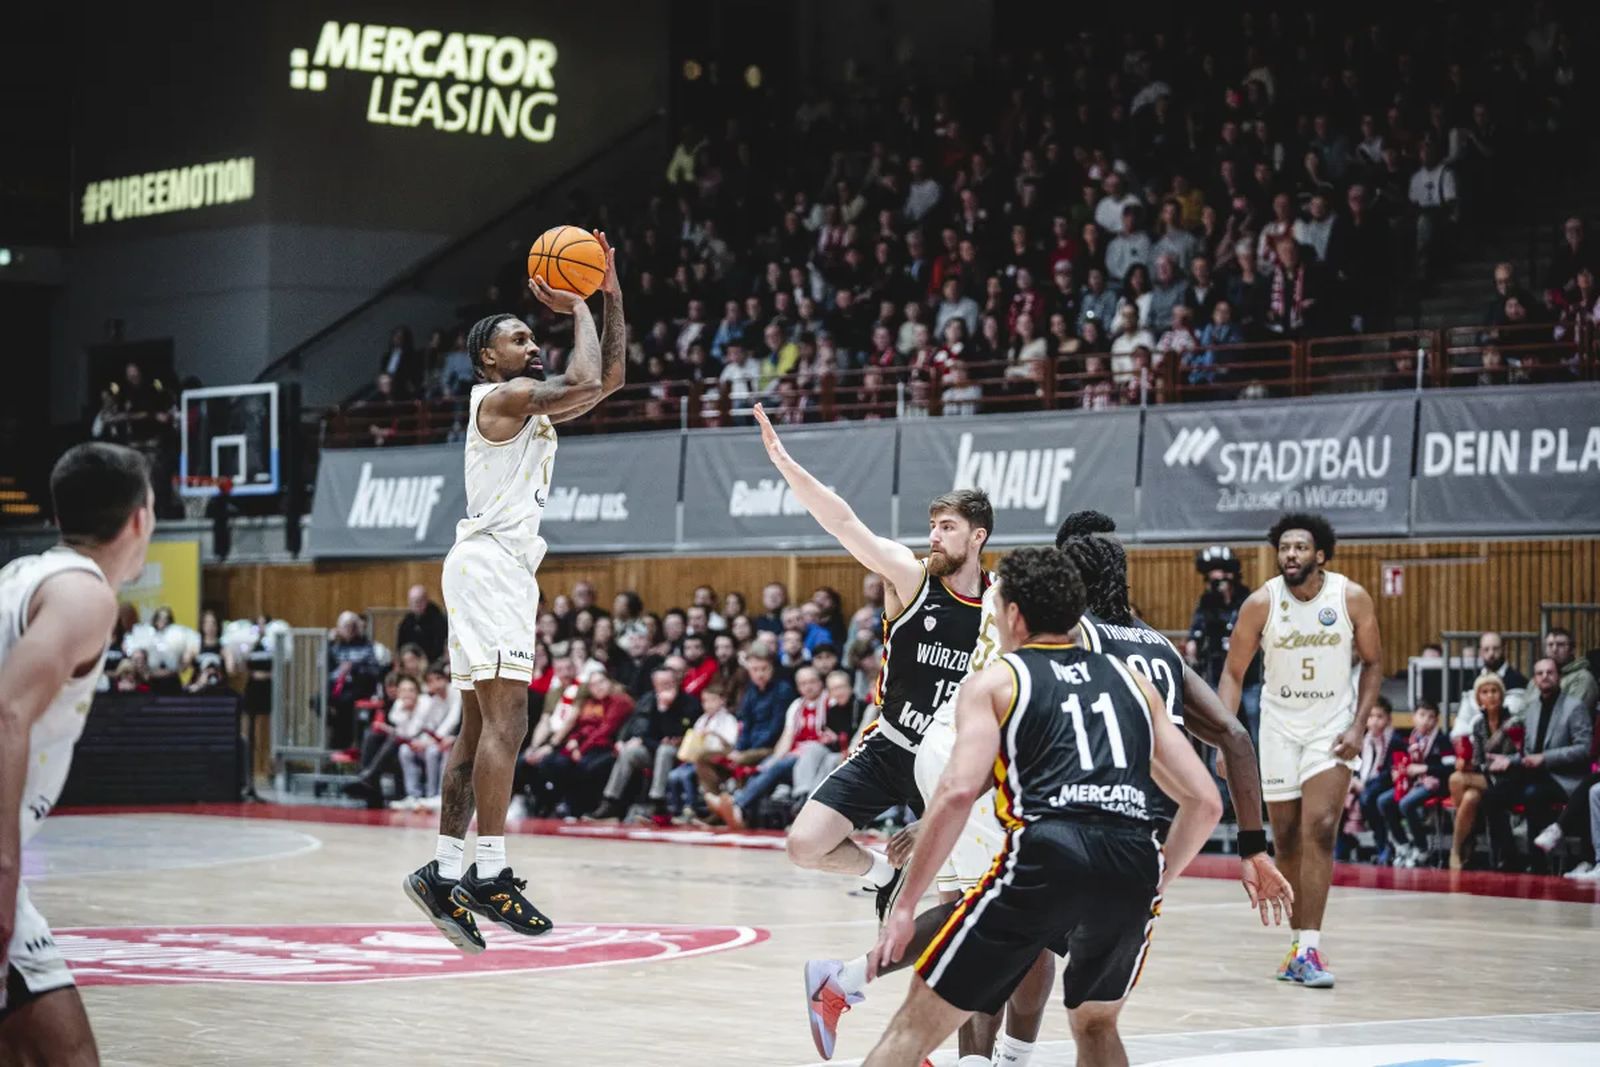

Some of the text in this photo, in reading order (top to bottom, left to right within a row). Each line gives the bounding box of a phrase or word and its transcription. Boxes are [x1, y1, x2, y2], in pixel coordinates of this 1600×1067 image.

[313, 21, 558, 89] MERCATOR
[367, 76, 558, 142] LEASING
[82, 156, 255, 224] #PUREEMOTION
[1217, 435, 1391, 484] STADTBAU
[1424, 426, 1600, 477] DEIN PLA
[1216, 484, 1388, 512] Zuhause in Würzburg
[1096, 623, 1168, 647] THOMPSON
[1273, 629, 1341, 649] Levice
[916, 641, 970, 672] WÜRZB
[1302, 657, 1315, 681] 5
[1049, 659, 1091, 685] NEY
[1294, 690, 1335, 699] VEOLIA
[1060, 692, 1128, 771] 11
[1059, 784, 1146, 808] MERCATOR
